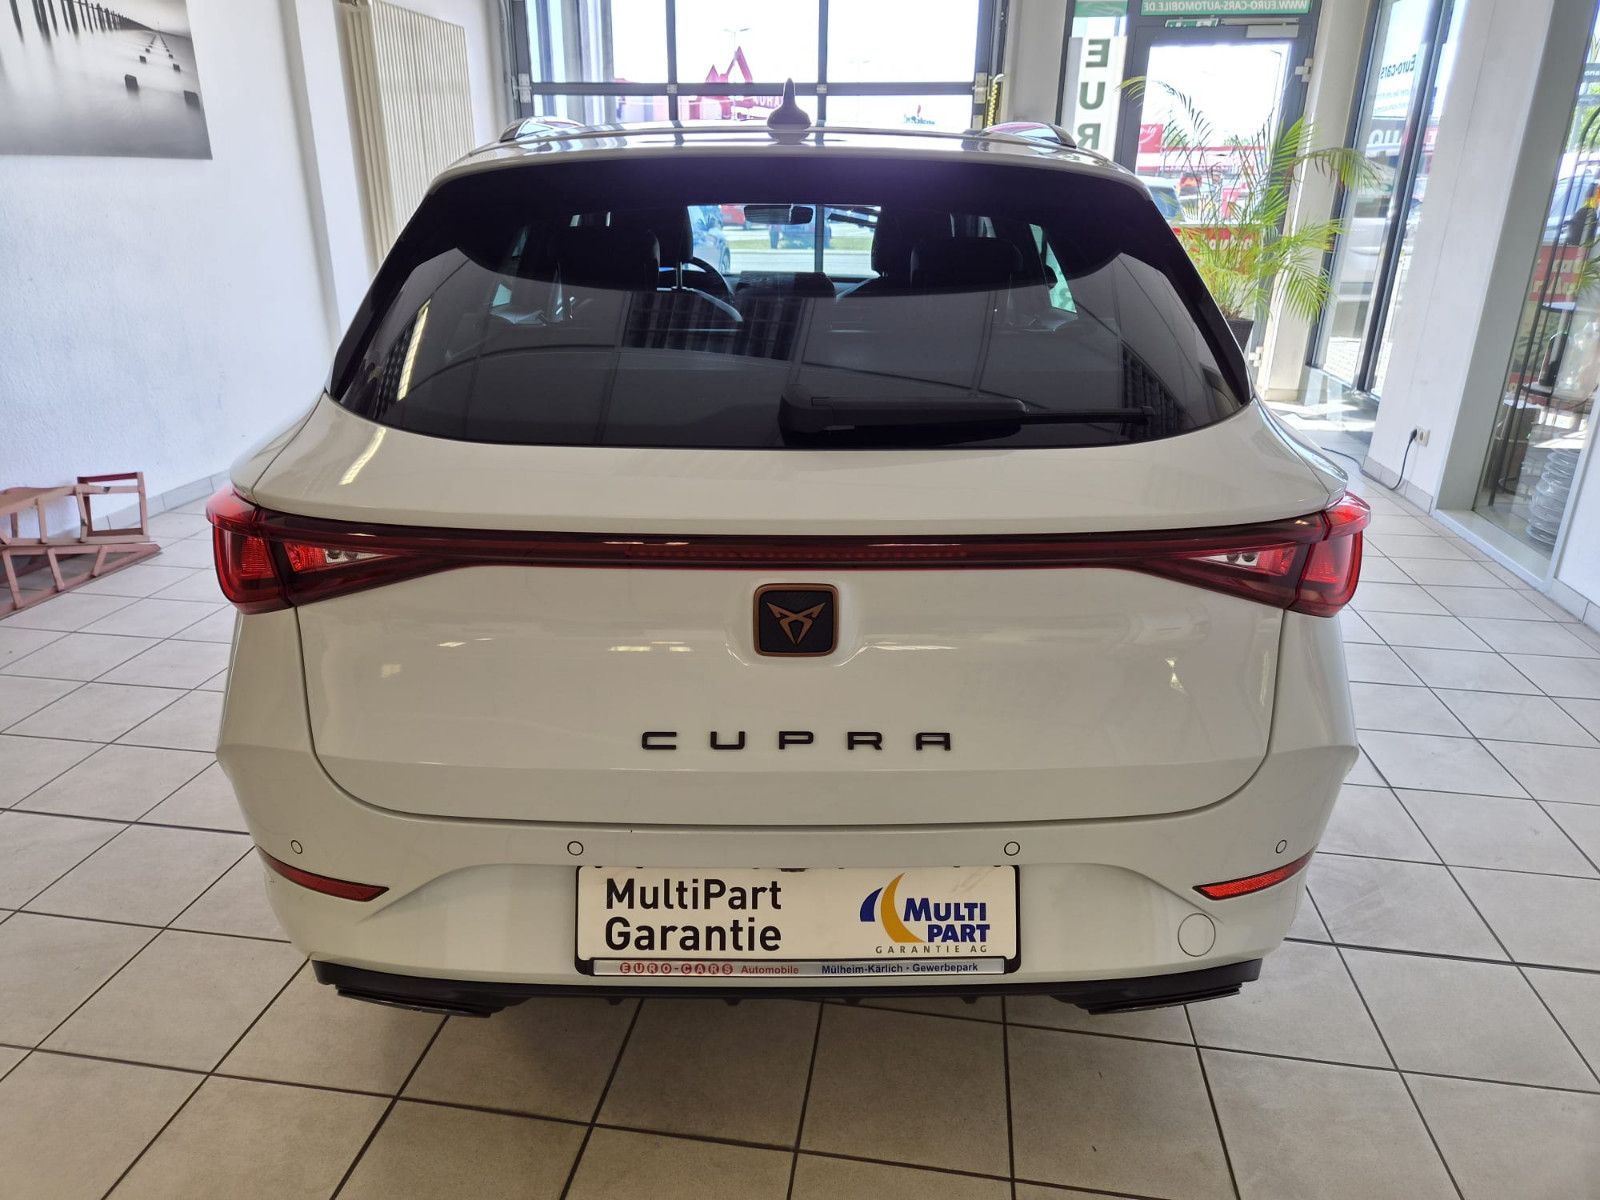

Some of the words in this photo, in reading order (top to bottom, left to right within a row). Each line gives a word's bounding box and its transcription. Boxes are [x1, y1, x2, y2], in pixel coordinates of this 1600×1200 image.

[641, 730, 952, 751] CUPRA
[605, 877, 783, 910] MultiPart
[604, 916, 783, 952] Garantie
[926, 923, 991, 943] PART
[874, 944, 961, 954] GARANTIE
[969, 944, 988, 953] AG
[619, 961, 734, 976] EURO-CARS
[740, 964, 800, 975] Automobile
[821, 963, 904, 975] Mülheim-Kärlich
[912, 962, 979, 974] Gewerbepark
